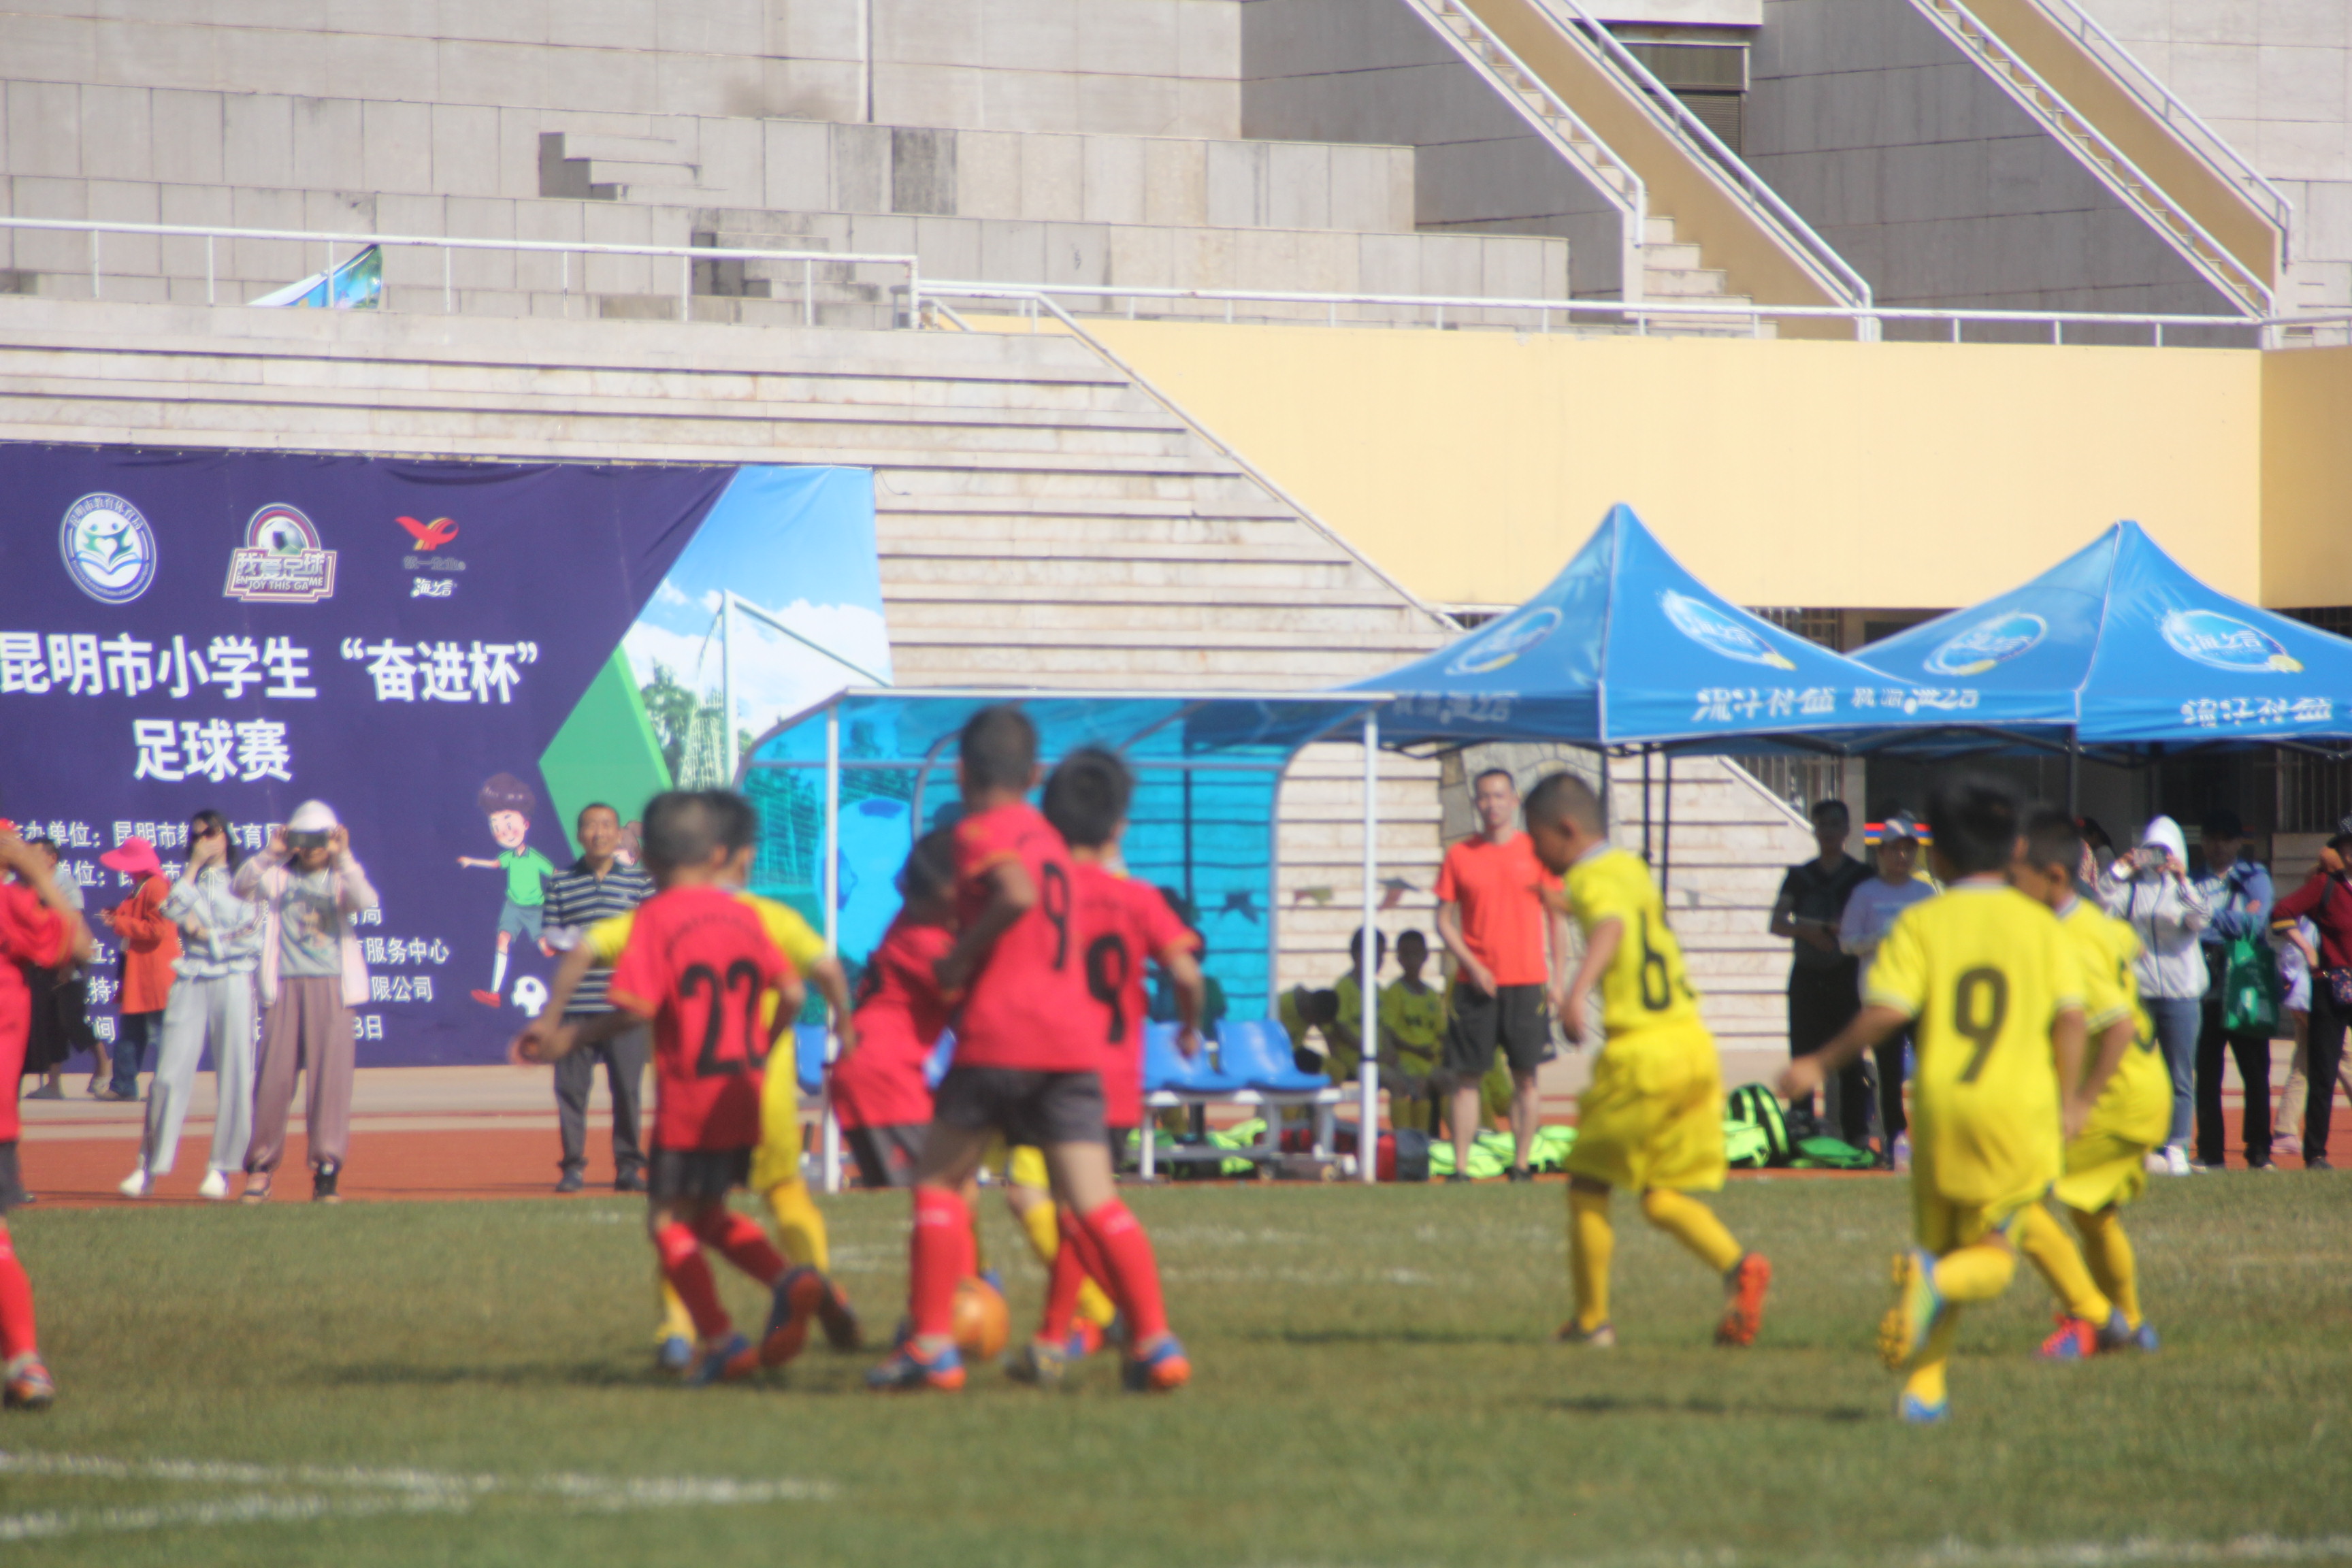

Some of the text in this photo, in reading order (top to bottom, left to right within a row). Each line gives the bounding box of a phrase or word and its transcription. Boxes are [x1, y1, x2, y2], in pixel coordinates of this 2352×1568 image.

[235, 576, 324, 590] ENJOY THIS GAME
[238, 552, 325, 581] 我爱足球
[0, 631, 539, 704] 昆明市小学生 “奋进杯”
[133, 718, 293, 783] 足球赛
[1954, 966, 2008, 1085] 9
